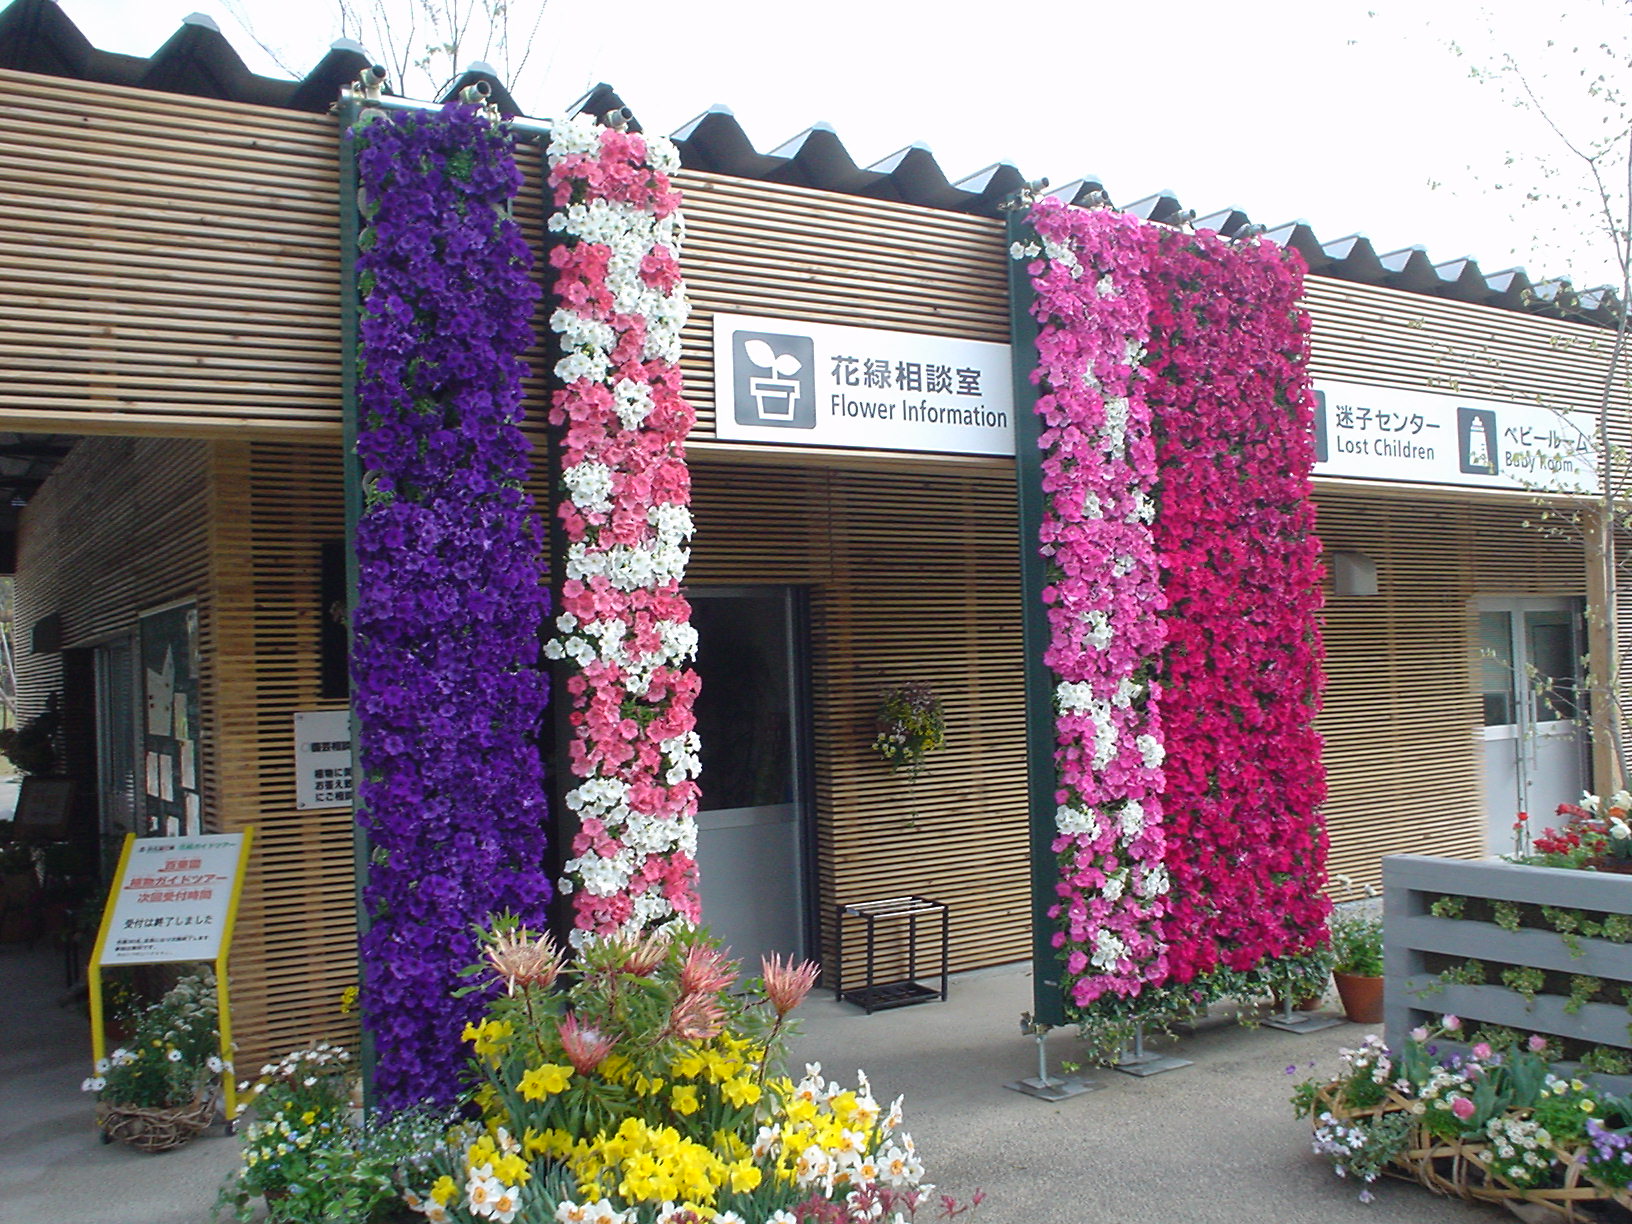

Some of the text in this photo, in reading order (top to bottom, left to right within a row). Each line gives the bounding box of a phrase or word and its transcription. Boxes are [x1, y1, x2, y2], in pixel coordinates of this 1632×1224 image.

[831, 355, 983, 397] 花緑相談室
[831, 394, 1008, 428] Flower Information
[1336, 405, 1441, 434] 迷子センター
[1336, 436, 1435, 460] Lost Children
[1504, 427, 1588, 453] ベビールーム
[123, 915, 214, 929] 受付は終了しました
